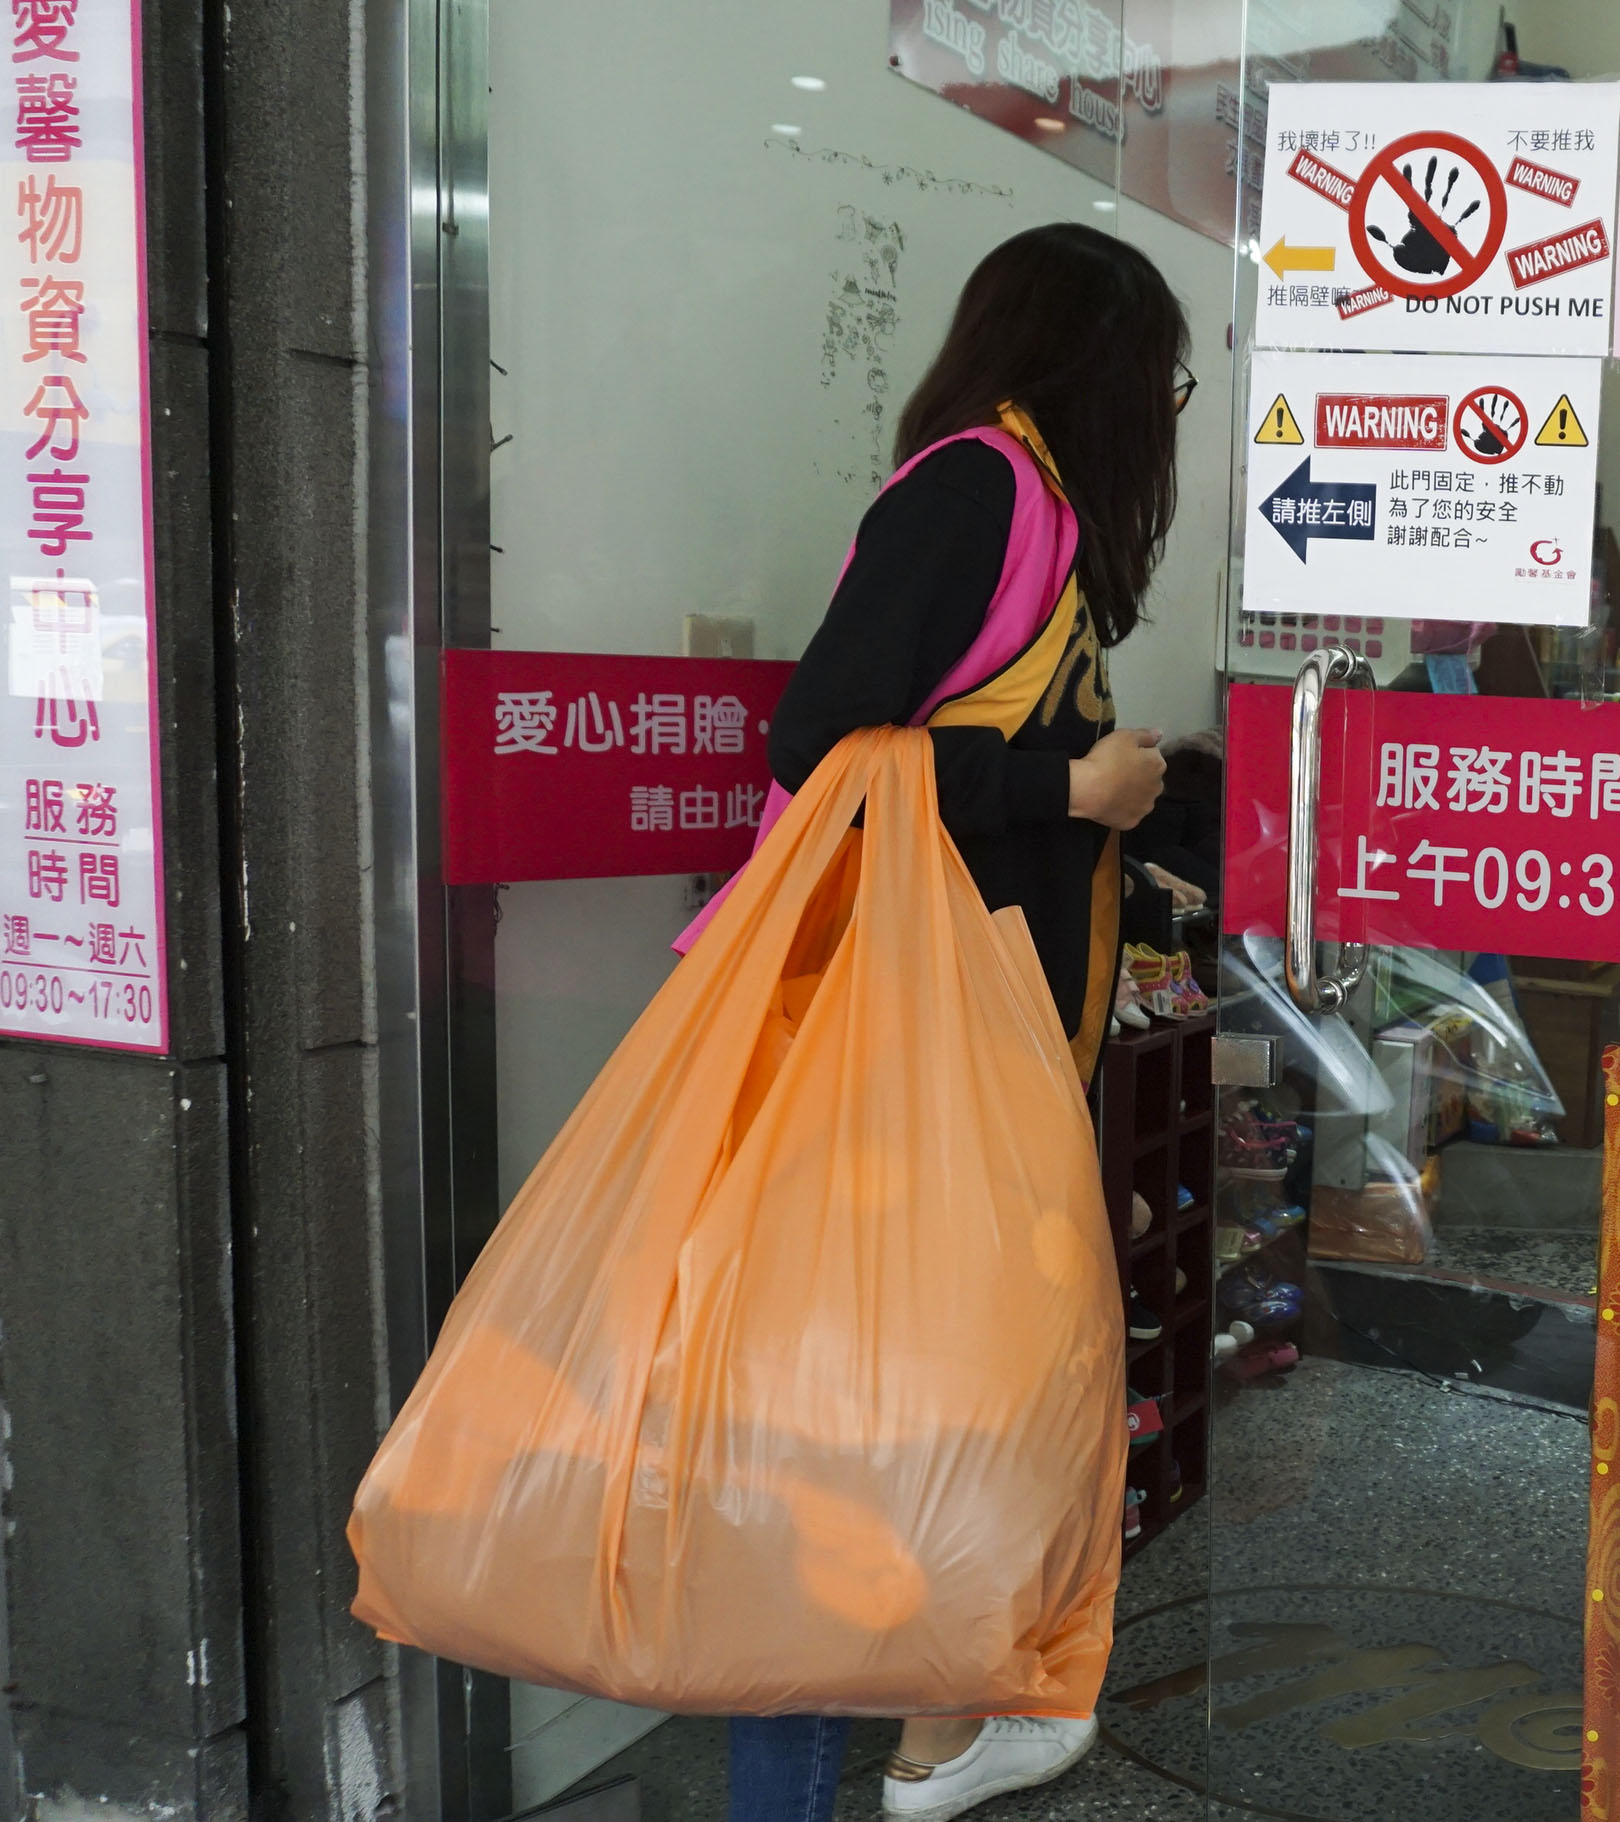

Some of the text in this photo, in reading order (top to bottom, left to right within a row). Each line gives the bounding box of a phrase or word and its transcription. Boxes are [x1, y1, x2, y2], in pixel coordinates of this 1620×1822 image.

[998, 30, 1060, 104] share
[1507, 129, 1596, 151] 不要推我
[1294, 155, 1356, 205] WARNING
[1511, 162, 1573, 204] WARNING
[1514, 228, 1604, 280] WARNING
[1340, 286, 1390, 316] WARNING
[1405, 295, 1605, 318] DO NOT PUSH ME
[1325, 405, 1438, 441] WARNING
[1272, 498, 1372, 527] 請推左側
[1389, 497, 1518, 523] 為了您的安全
[25, 778, 118, 838] 服務
[630, 783, 765, 831] 請由此
[28, 848, 121, 908] 時間
[0, 969, 152, 1025] 09:30~17:30
